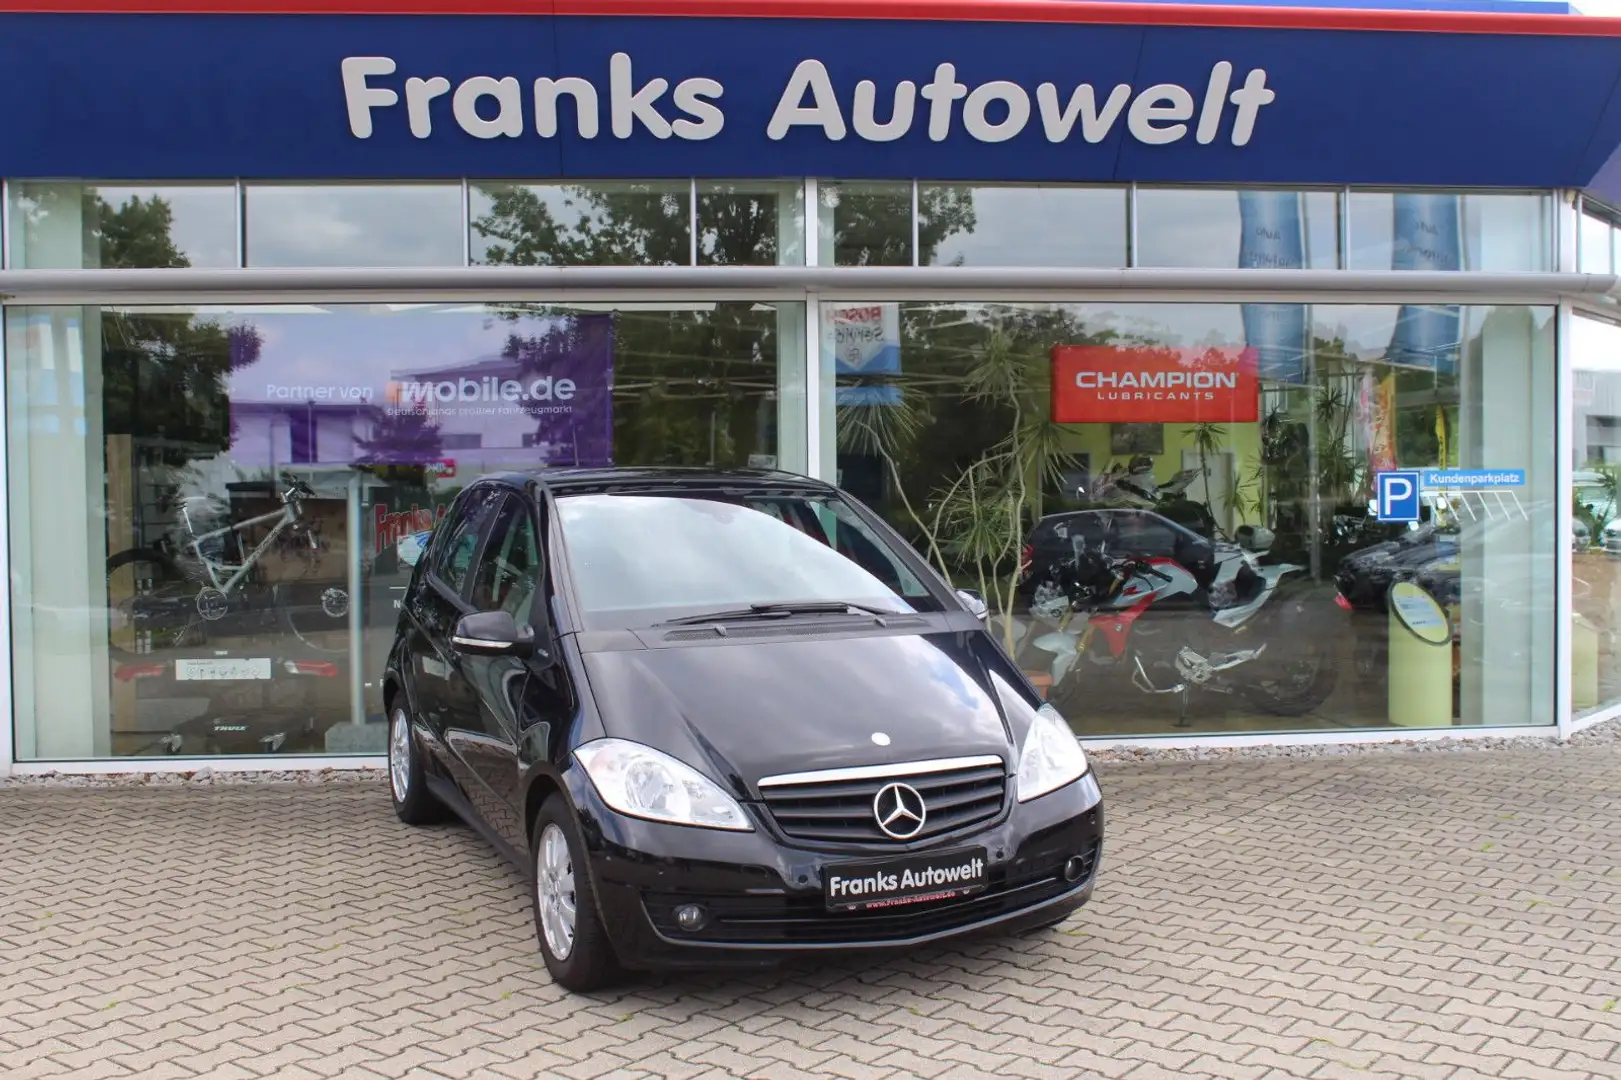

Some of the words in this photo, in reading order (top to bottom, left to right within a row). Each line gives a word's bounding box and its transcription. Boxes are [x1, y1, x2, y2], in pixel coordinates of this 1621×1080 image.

[341, 53, 724, 140] Franks
[766, 58, 1275, 146] Autowelt
[266, 384, 335, 399] Partner
[340, 387, 373, 399] von
[403, 377, 576, 402] mobile.de
[1076, 372, 1236, 388] CHAMPION
[1098, 392, 1214, 400] LUBRICANTS
[1384, 478, 1412, 515] P
[1430, 473, 1519, 486] Kundenparkplatz
[830, 872, 896, 897] Franks
[900, 858, 983, 889] Autowelt
